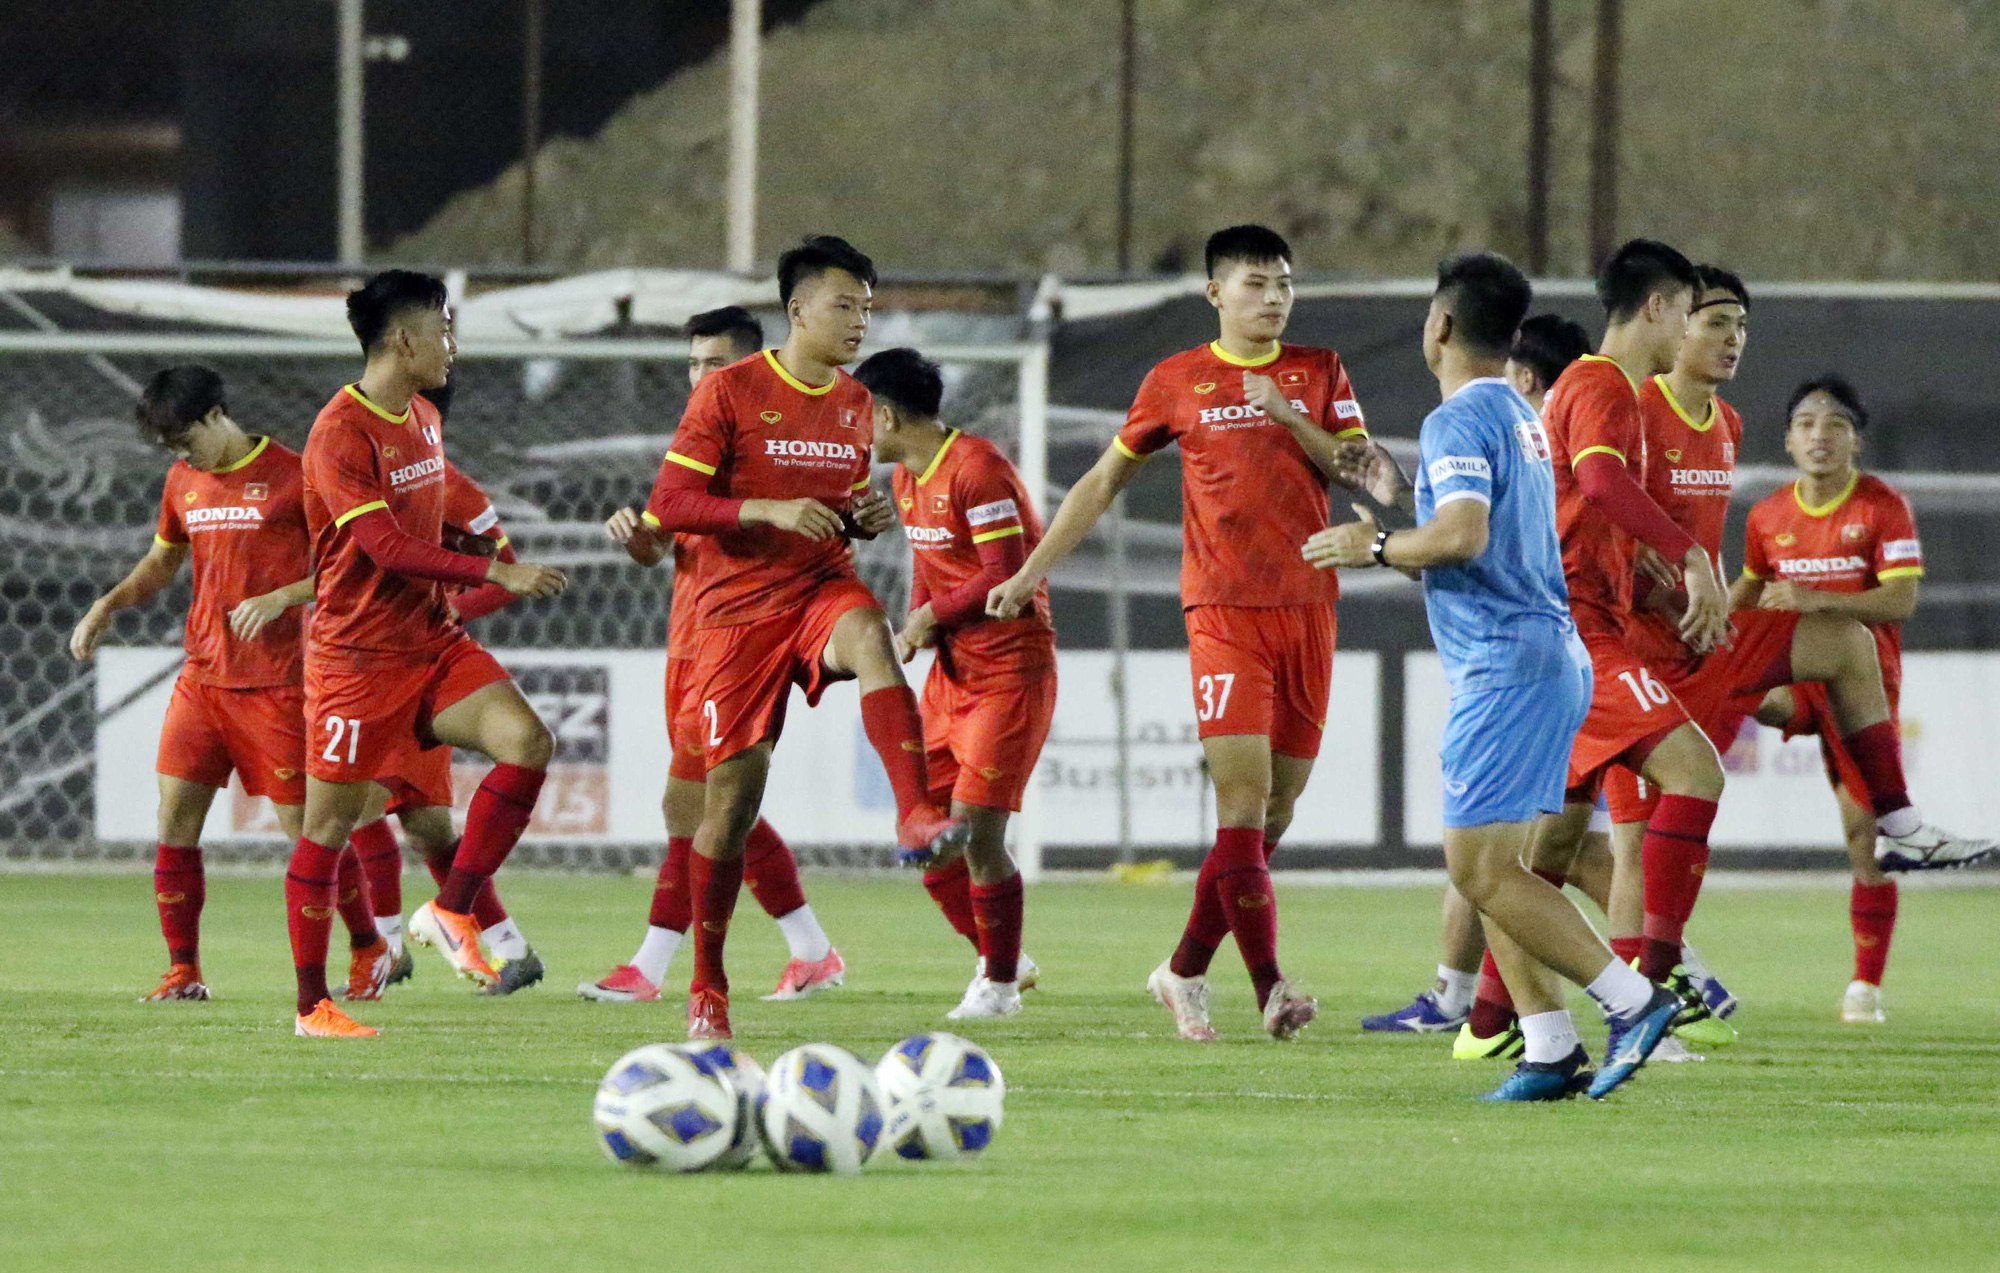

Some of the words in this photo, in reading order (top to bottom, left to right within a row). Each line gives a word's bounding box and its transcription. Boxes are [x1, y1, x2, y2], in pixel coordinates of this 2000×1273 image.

[1199, 399, 1310, 424] HONA
[1228, 420, 1255, 430] Power
[764, 439, 858, 460] HONDA
[390, 455, 446, 486] HONDA
[773, 457, 790, 467] The
[790, 459, 816, 468] Power
[826, 461, 852, 470] Dreams
[1670, 468, 1734, 485] HONDA
[185, 506, 264, 525] HONDA
[1779, 555, 1867, 573] HONDA
[1199, 673, 1235, 721] 37
[1617, 667, 1669, 712] 16
[704, 699, 724, 747] 2
[322, 715, 361, 764] 21
